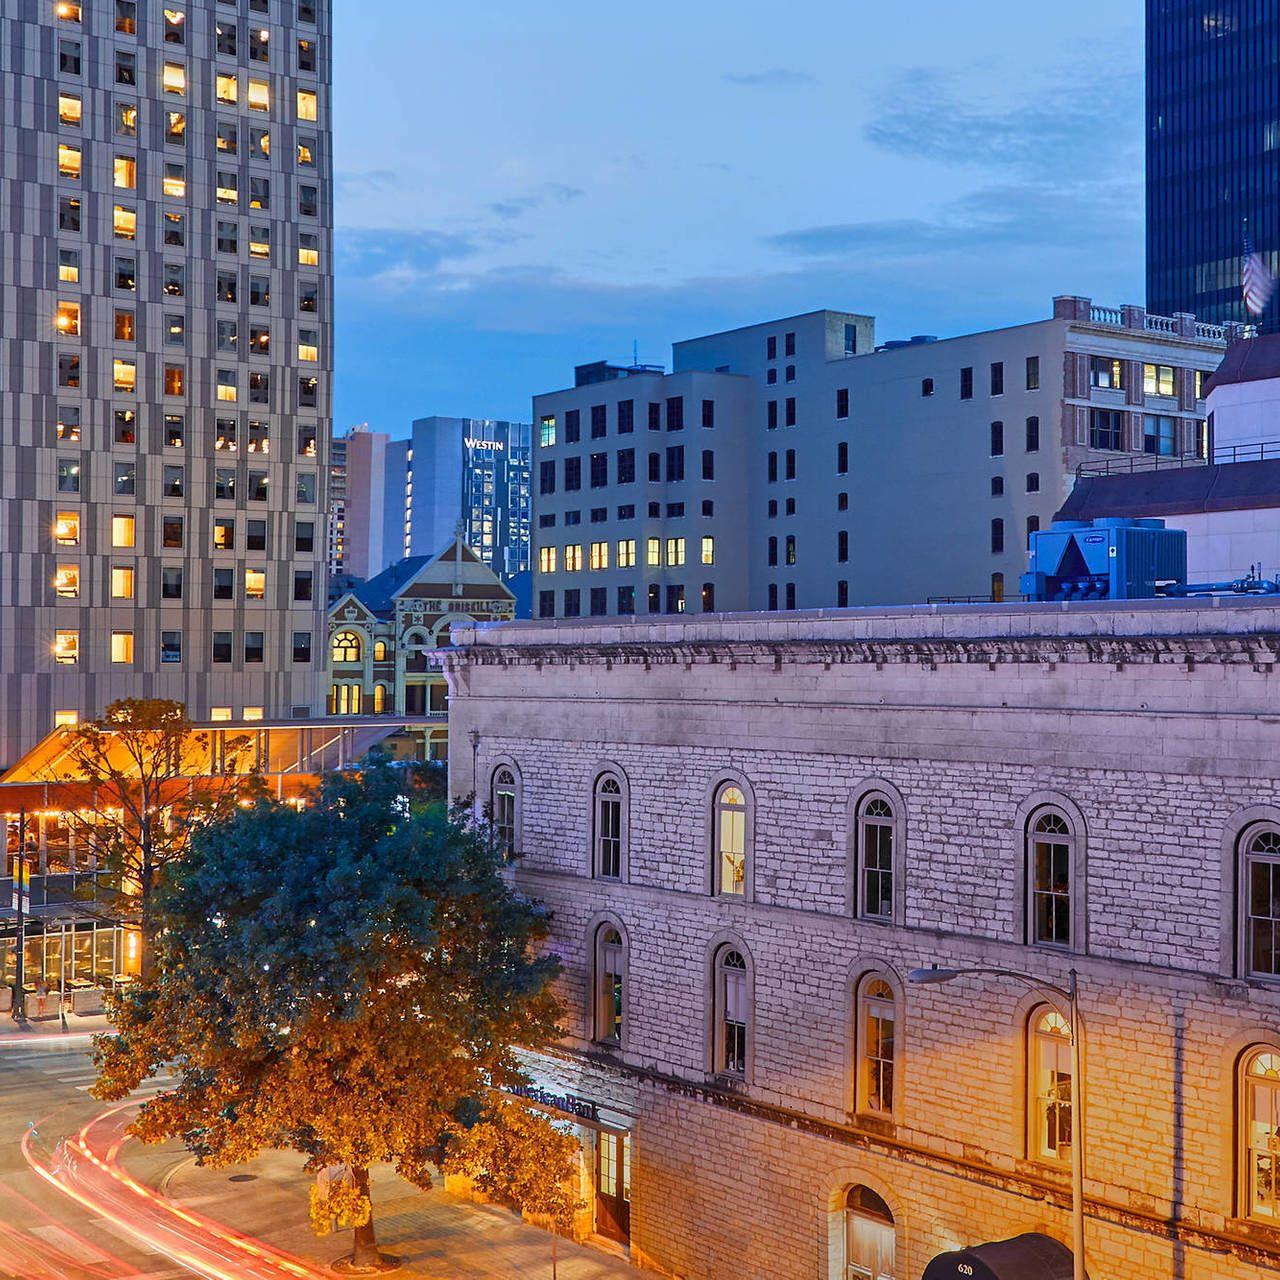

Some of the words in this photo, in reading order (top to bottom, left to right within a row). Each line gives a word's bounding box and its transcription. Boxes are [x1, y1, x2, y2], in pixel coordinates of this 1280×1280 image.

[423, 601, 441, 612] THE
[448, 601, 493, 613] DRISKILL
[957, 1263, 973, 1276] 620
